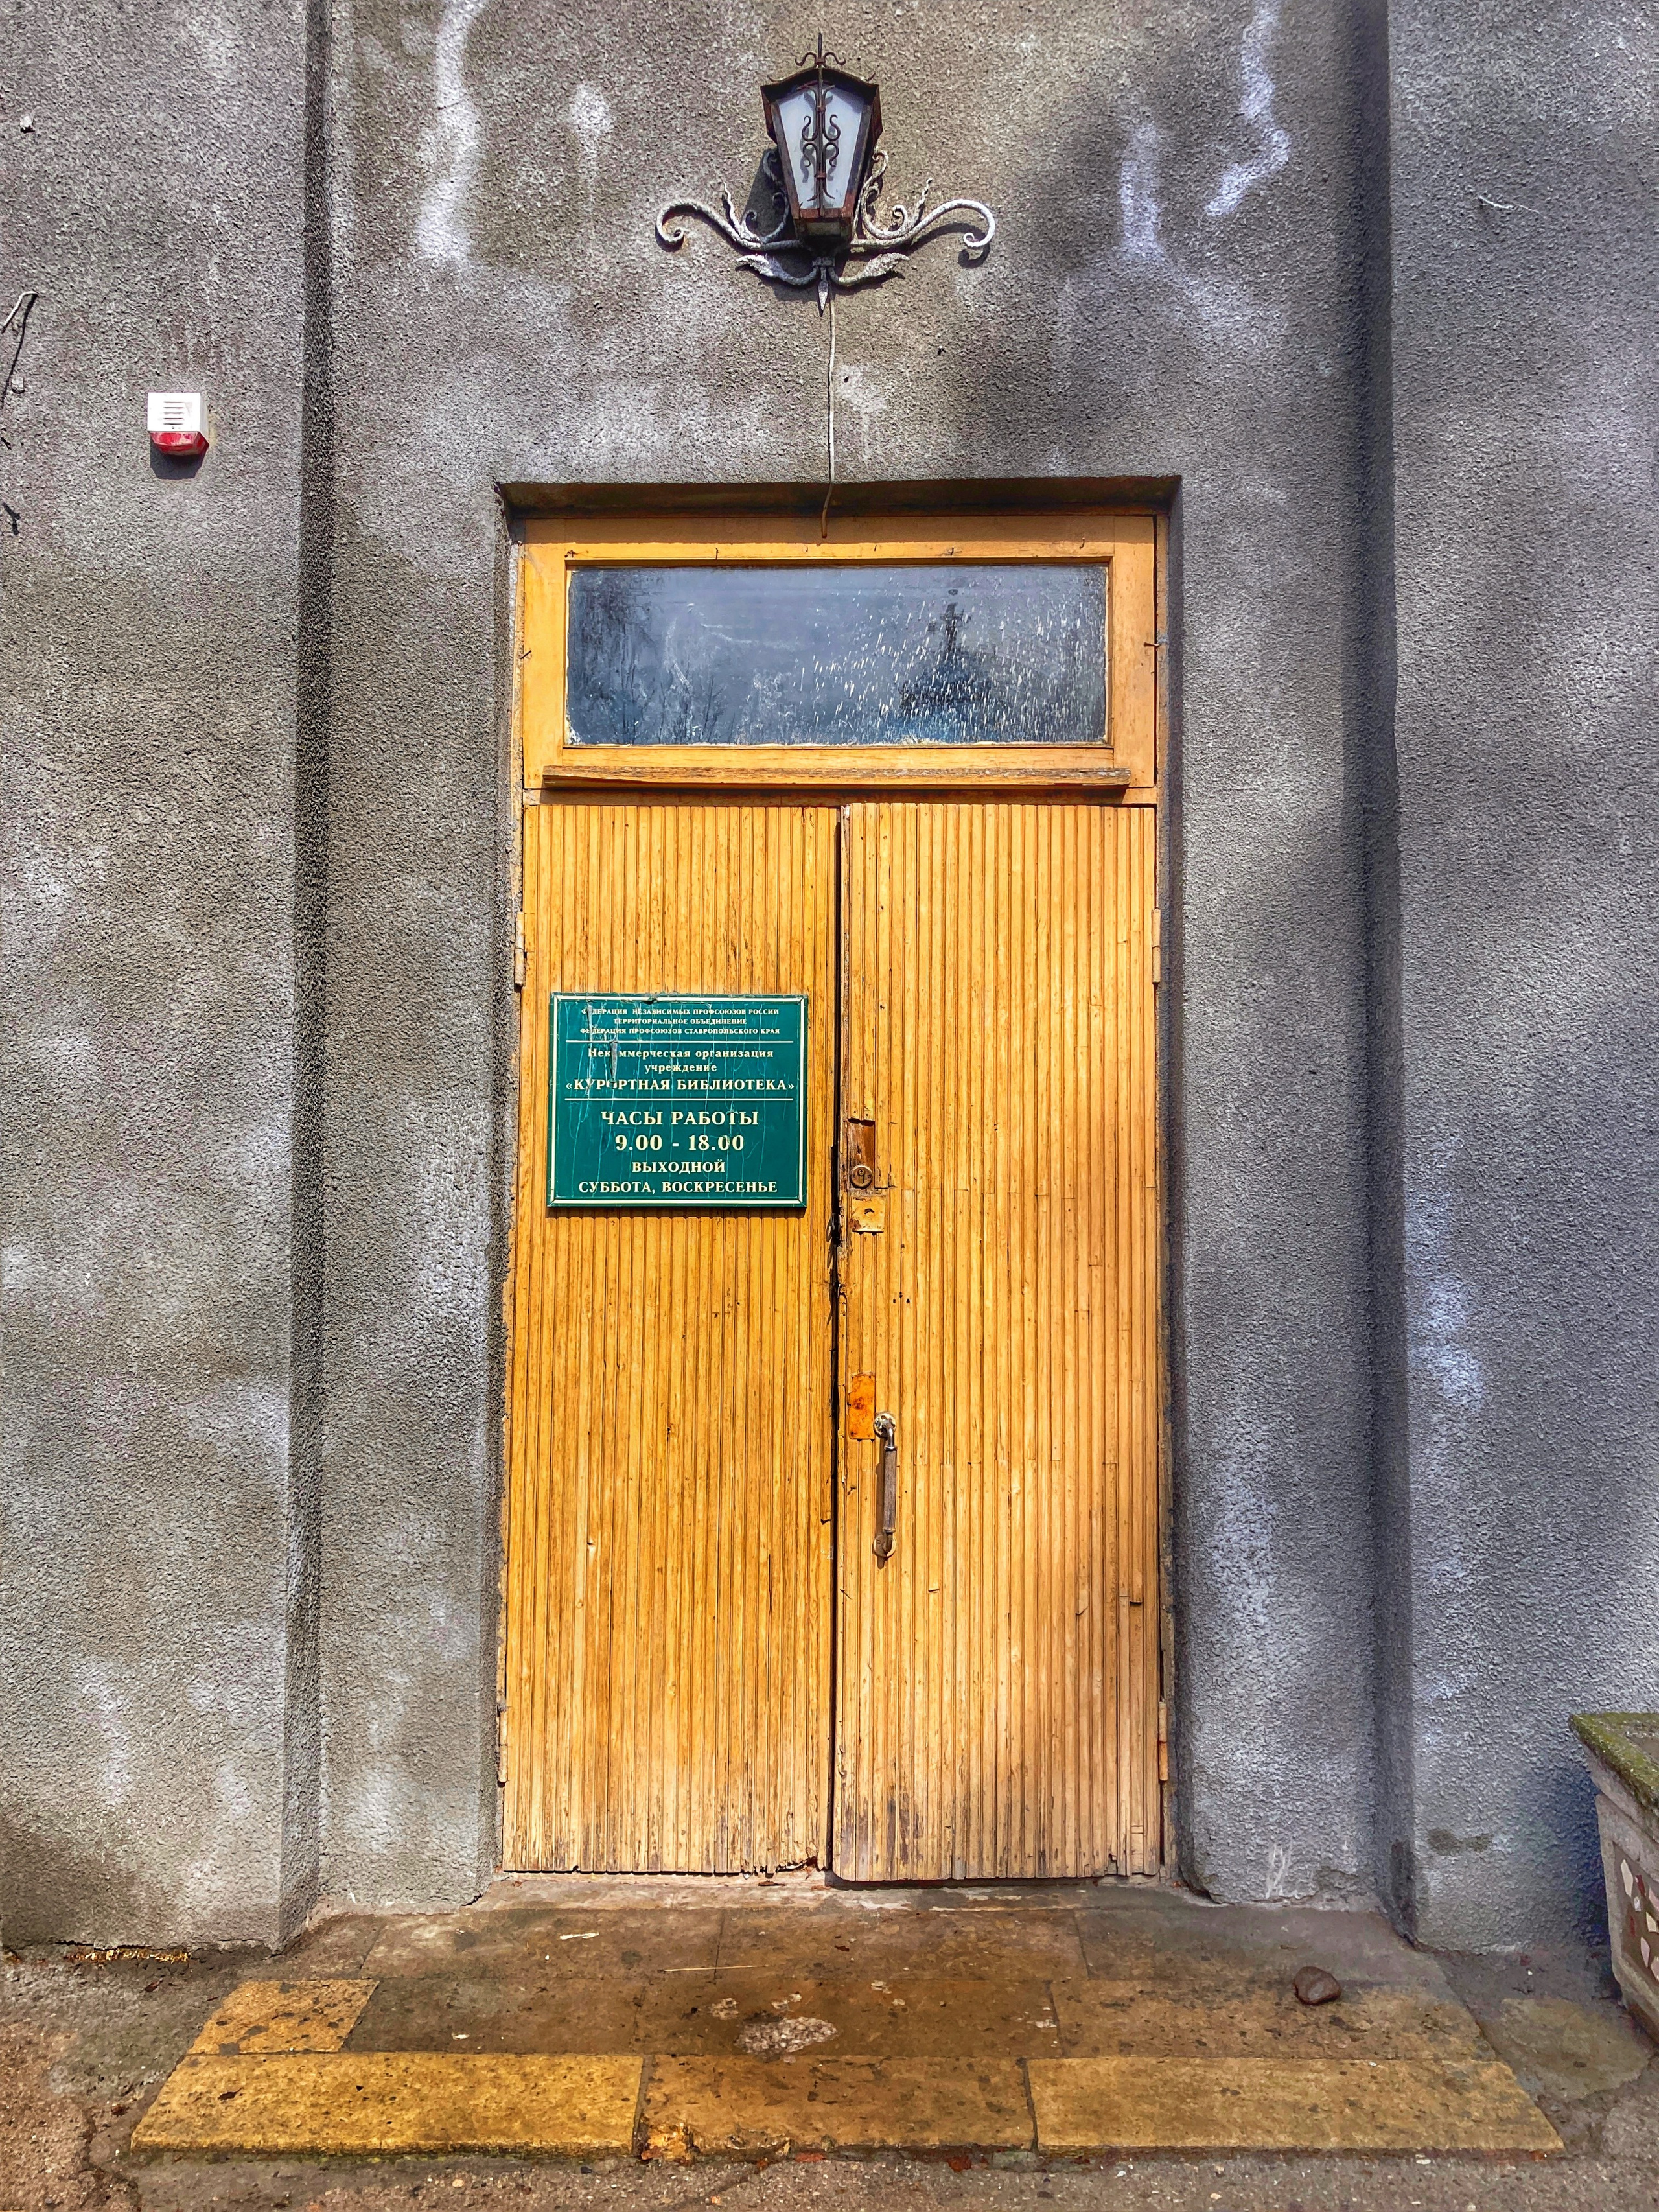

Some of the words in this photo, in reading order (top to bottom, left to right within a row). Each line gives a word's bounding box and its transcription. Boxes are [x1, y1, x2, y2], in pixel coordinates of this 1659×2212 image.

[587, 1048, 691, 1060] Некммерческая
[695, 1050, 773, 1060] организация
[644, 1064, 717, 1074] учреждение
[565, 1078, 671, 1090] «КУРОРТНАЯ
[677, 1079, 795, 1091] БИБЛИОТЕКА»
[601, 1111, 663, 1125] ЧАСЫ
[671, 1111, 759, 1125] РАБОТЫ
[615, 1135, 662, 1150] 9.00
[688, 1135, 744, 1150] 18.00
[631, 1159, 726, 1174] ВЫХОДНОЙ
[579, 1182, 655, 1194] СУББОТА,
[662, 1182, 778, 1193] ВОСКРЕСЕНЬЕ
